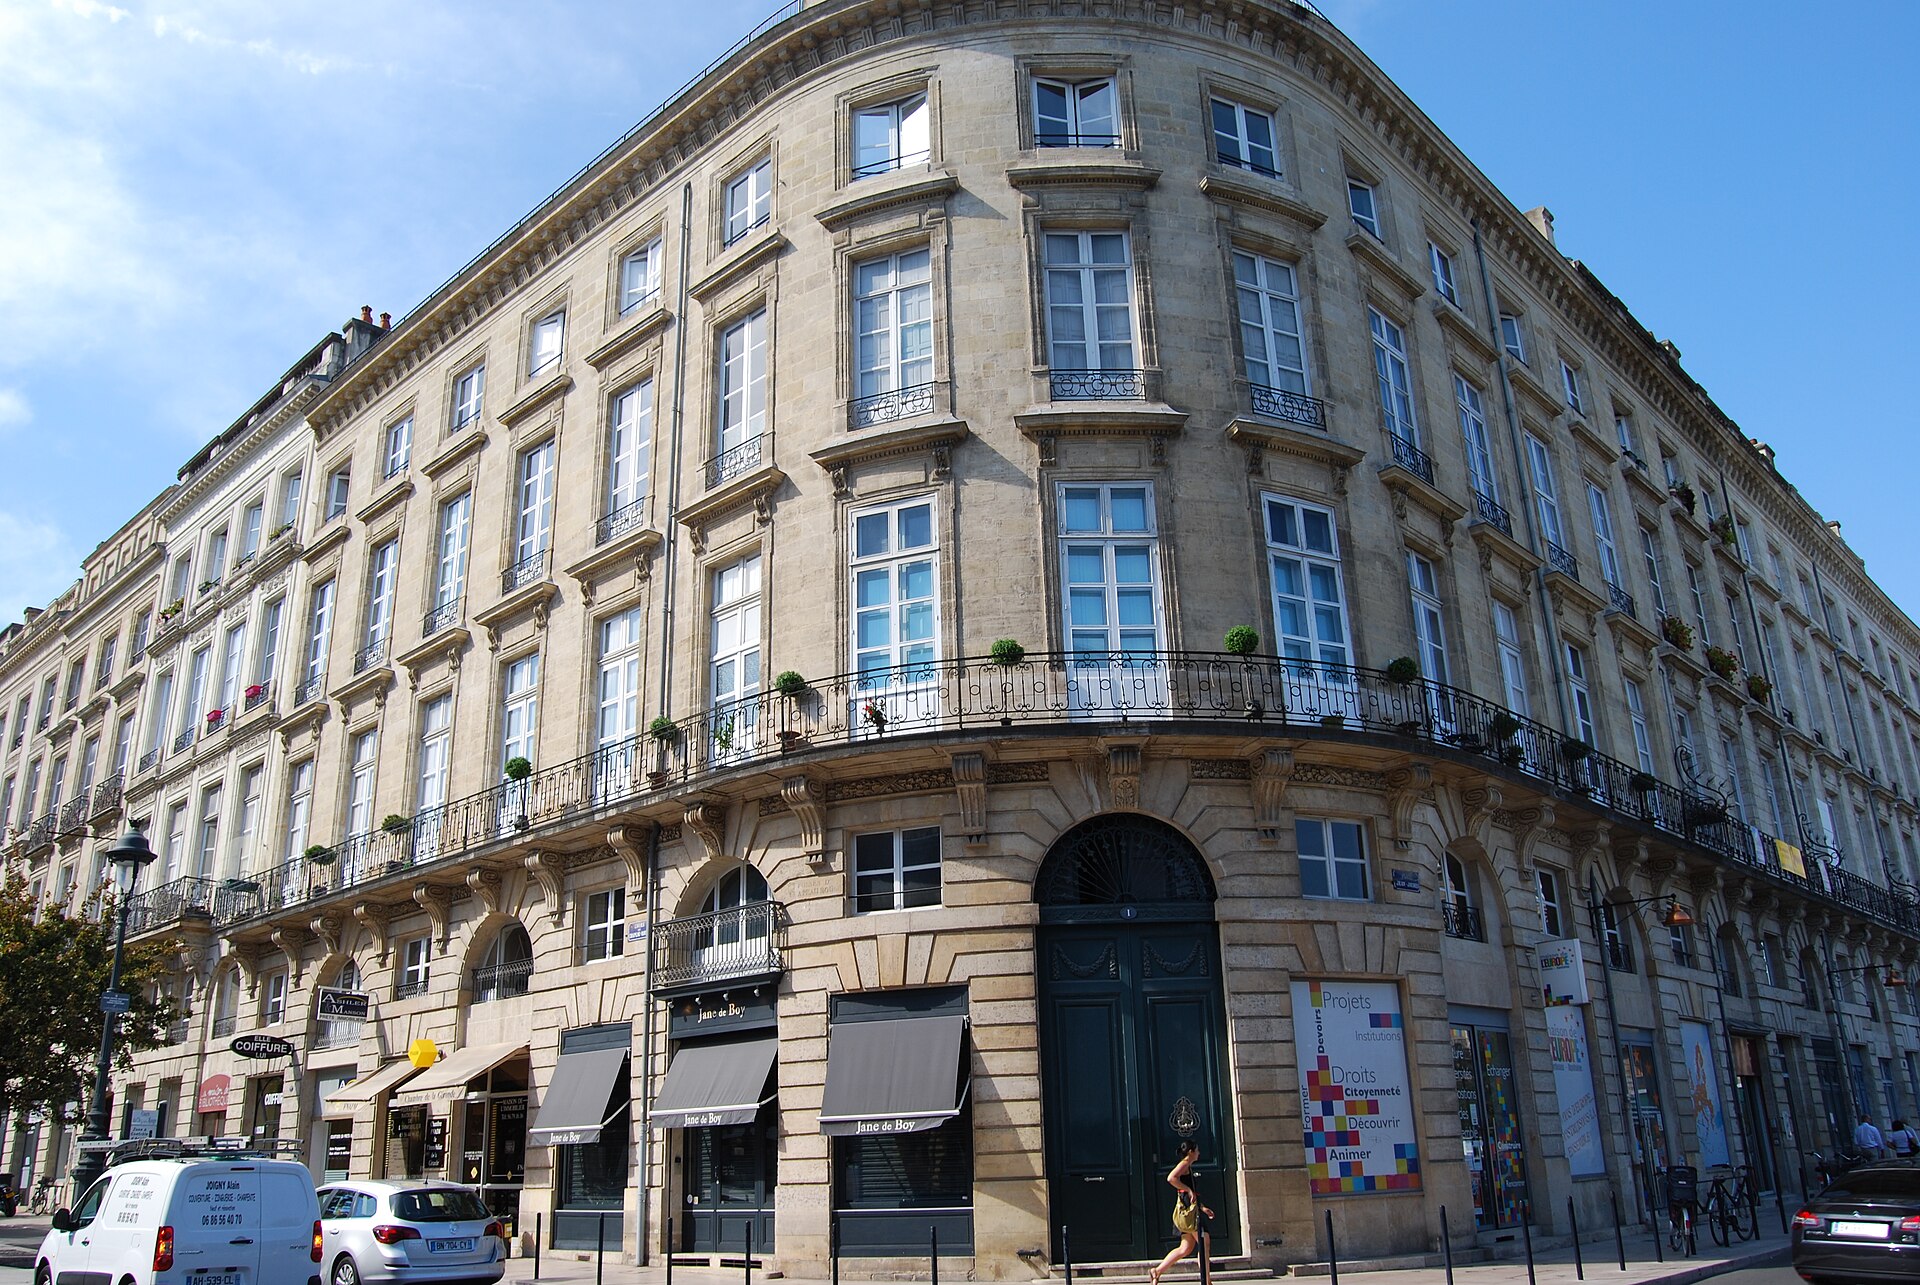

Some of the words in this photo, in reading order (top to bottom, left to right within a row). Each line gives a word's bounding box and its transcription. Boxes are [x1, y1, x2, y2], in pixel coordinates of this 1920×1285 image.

[321, 993, 368, 1006] ASHLER
[1323, 991, 1372, 1014] Projets
[331, 1004, 366, 1016] MANSON
[698, 1008, 717, 1023] Jane
[718, 1008, 727, 1017] de
[728, 1003, 746, 1018] Boy
[1314, 1008, 1325, 1054] Devoirs
[1355, 1030, 1401, 1042] Institutions
[235, 1041, 288, 1053] COIFFURE
[1331, 1065, 1377, 1084] Droits
[1344, 1085, 1401, 1099] Citoyenneté
[1301, 1084, 1311, 1130] Former
[683, 1114, 699, 1127] Jane
[700, 1115, 707, 1124] de
[708, 1113, 722, 1125] Boy
[856, 1120, 880, 1135] Jane
[881, 1121, 893, 1131] de
[894, 1119, 916, 1132] Boy
[1348, 1116, 1401, 1130] Découvrir
[550, 1133, 562, 1144] Jane
[562, 1134, 569, 1142] de
[569, 1132, 581, 1143] Boy
[1329, 1148, 1372, 1160] Animer
[205, 1181, 226, 1190] JOIGNY
[226, 1180, 240, 1190] Alain
[235, 1214, 243, 1224] 70
